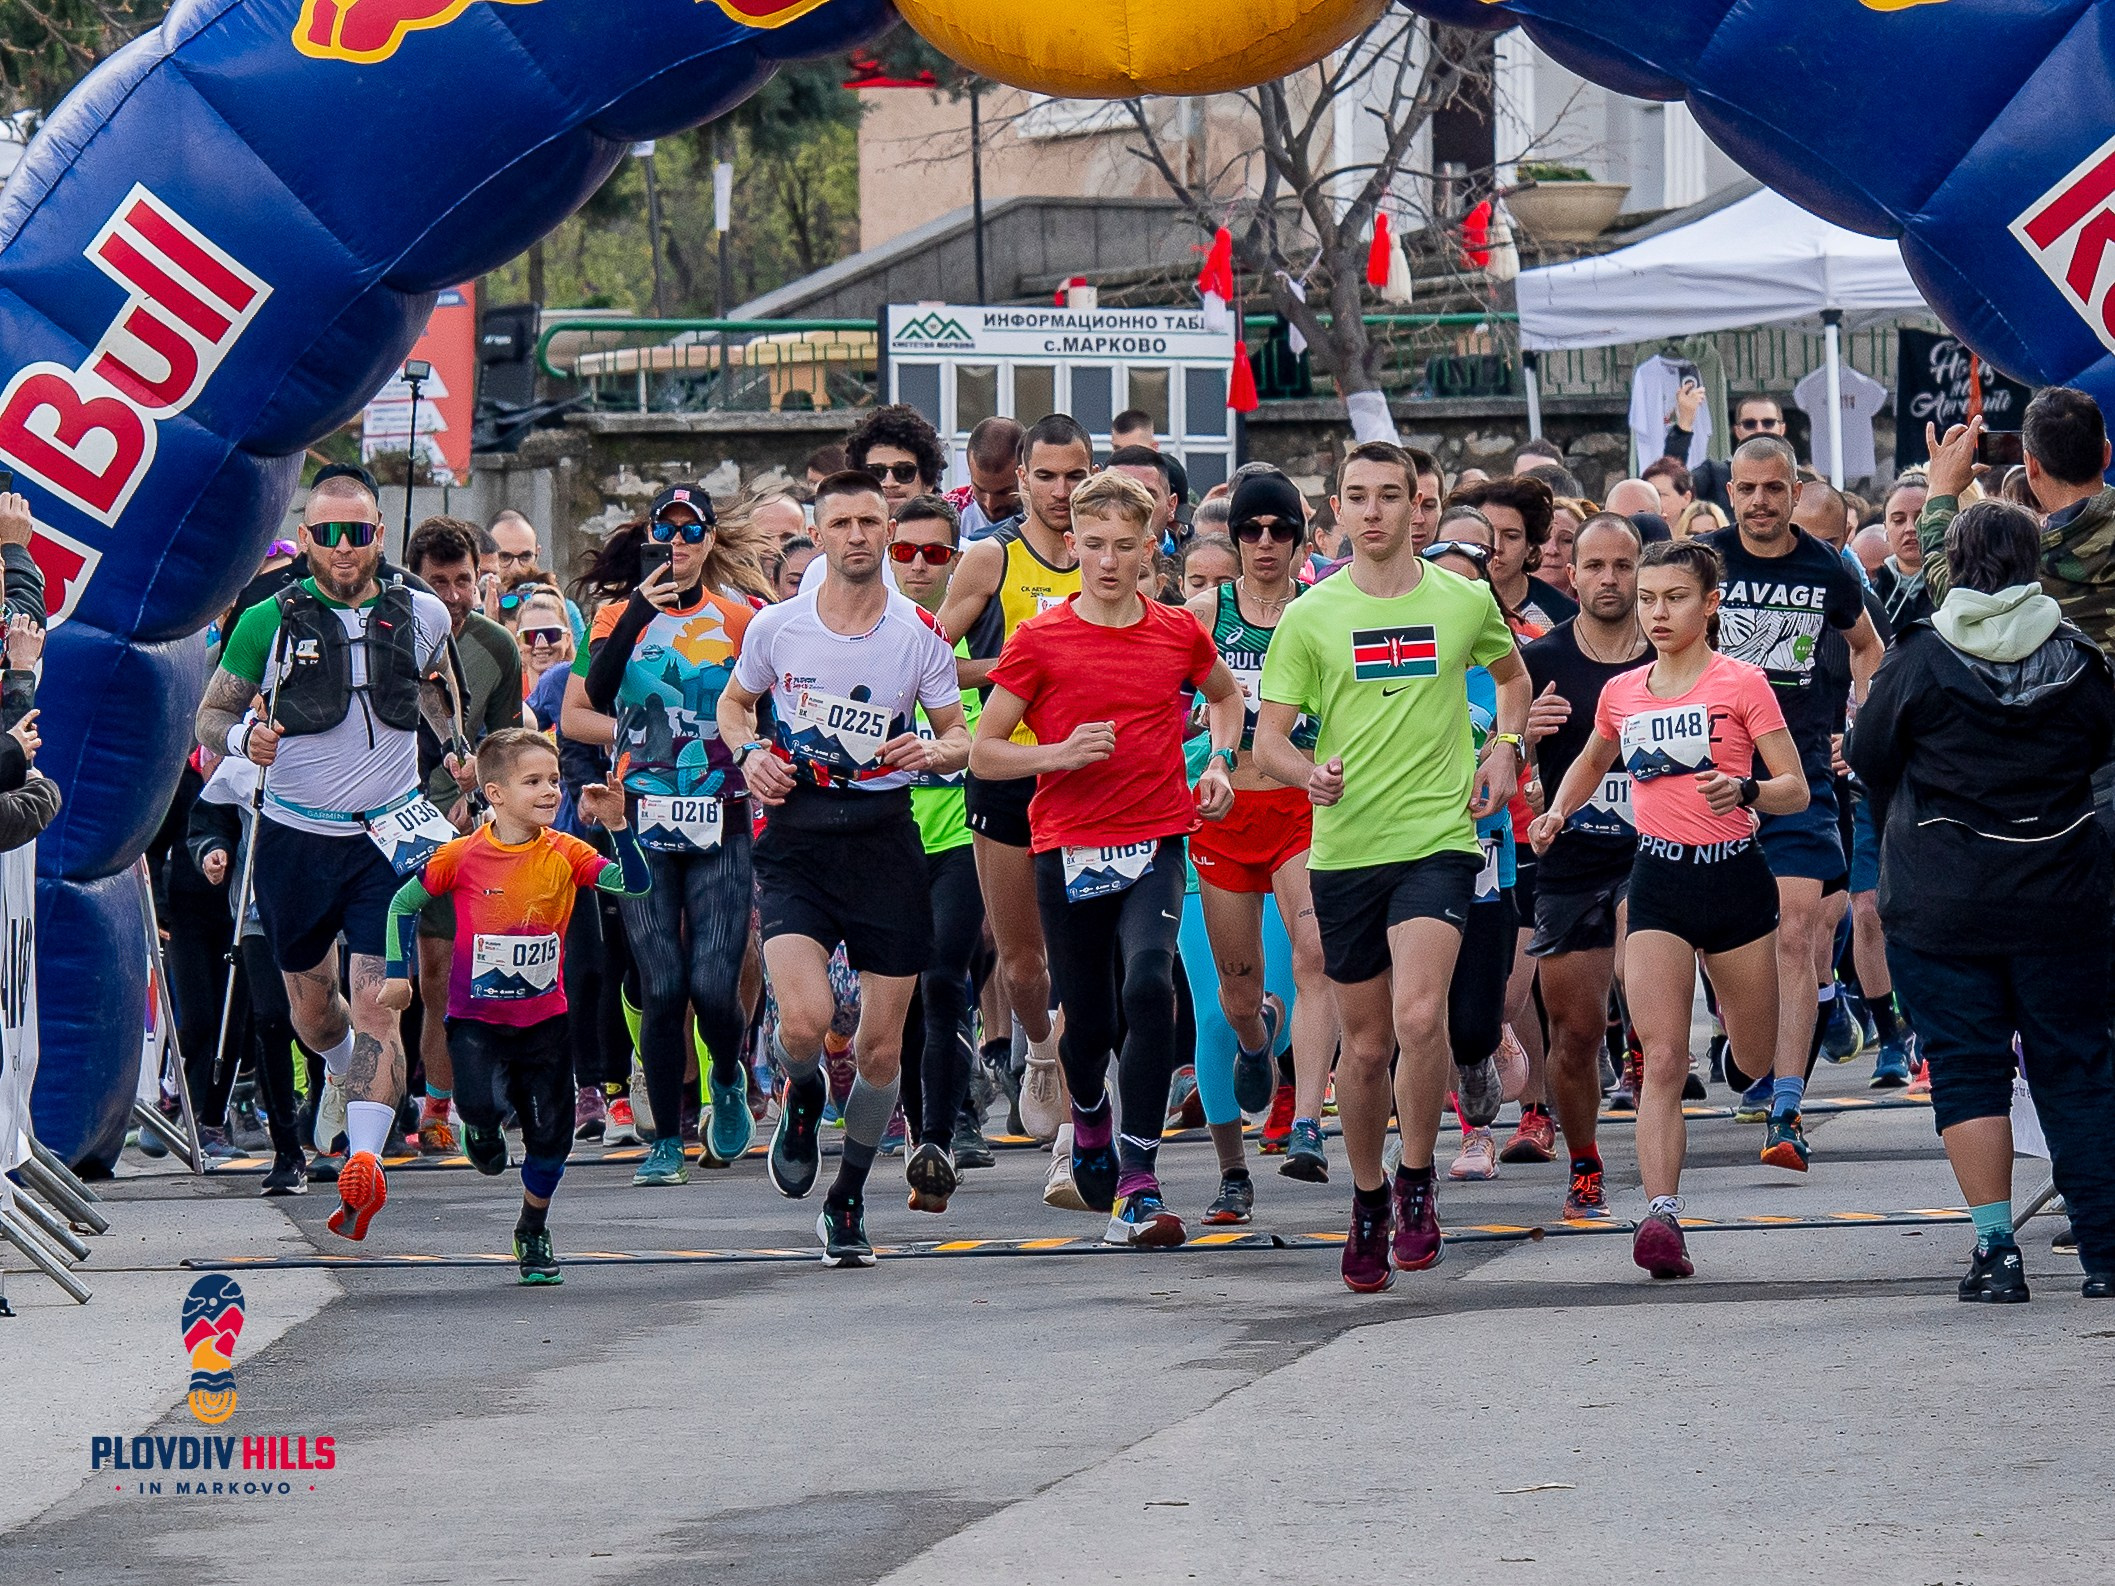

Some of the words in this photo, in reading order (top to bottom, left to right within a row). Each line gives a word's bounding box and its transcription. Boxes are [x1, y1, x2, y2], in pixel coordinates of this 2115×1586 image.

[983, 312, 1158, 331] ИНФОРМАЦИОННО
[0, 183, 270, 525] Bull
[1043, 336, 1167, 354] с.МАРКОВО
[1718, 580, 1827, 609] SAVAGE
[827, 704, 886, 738] 0225
[1651, 711, 1703, 742] 0148
[1605, 779, 1633, 803] 01
[307, 810, 345, 820] GARMIN
[1640, 834, 1684, 861] PRO
[1693, 838, 1750, 865] NIKE
[512, 937, 558, 967] 0215
